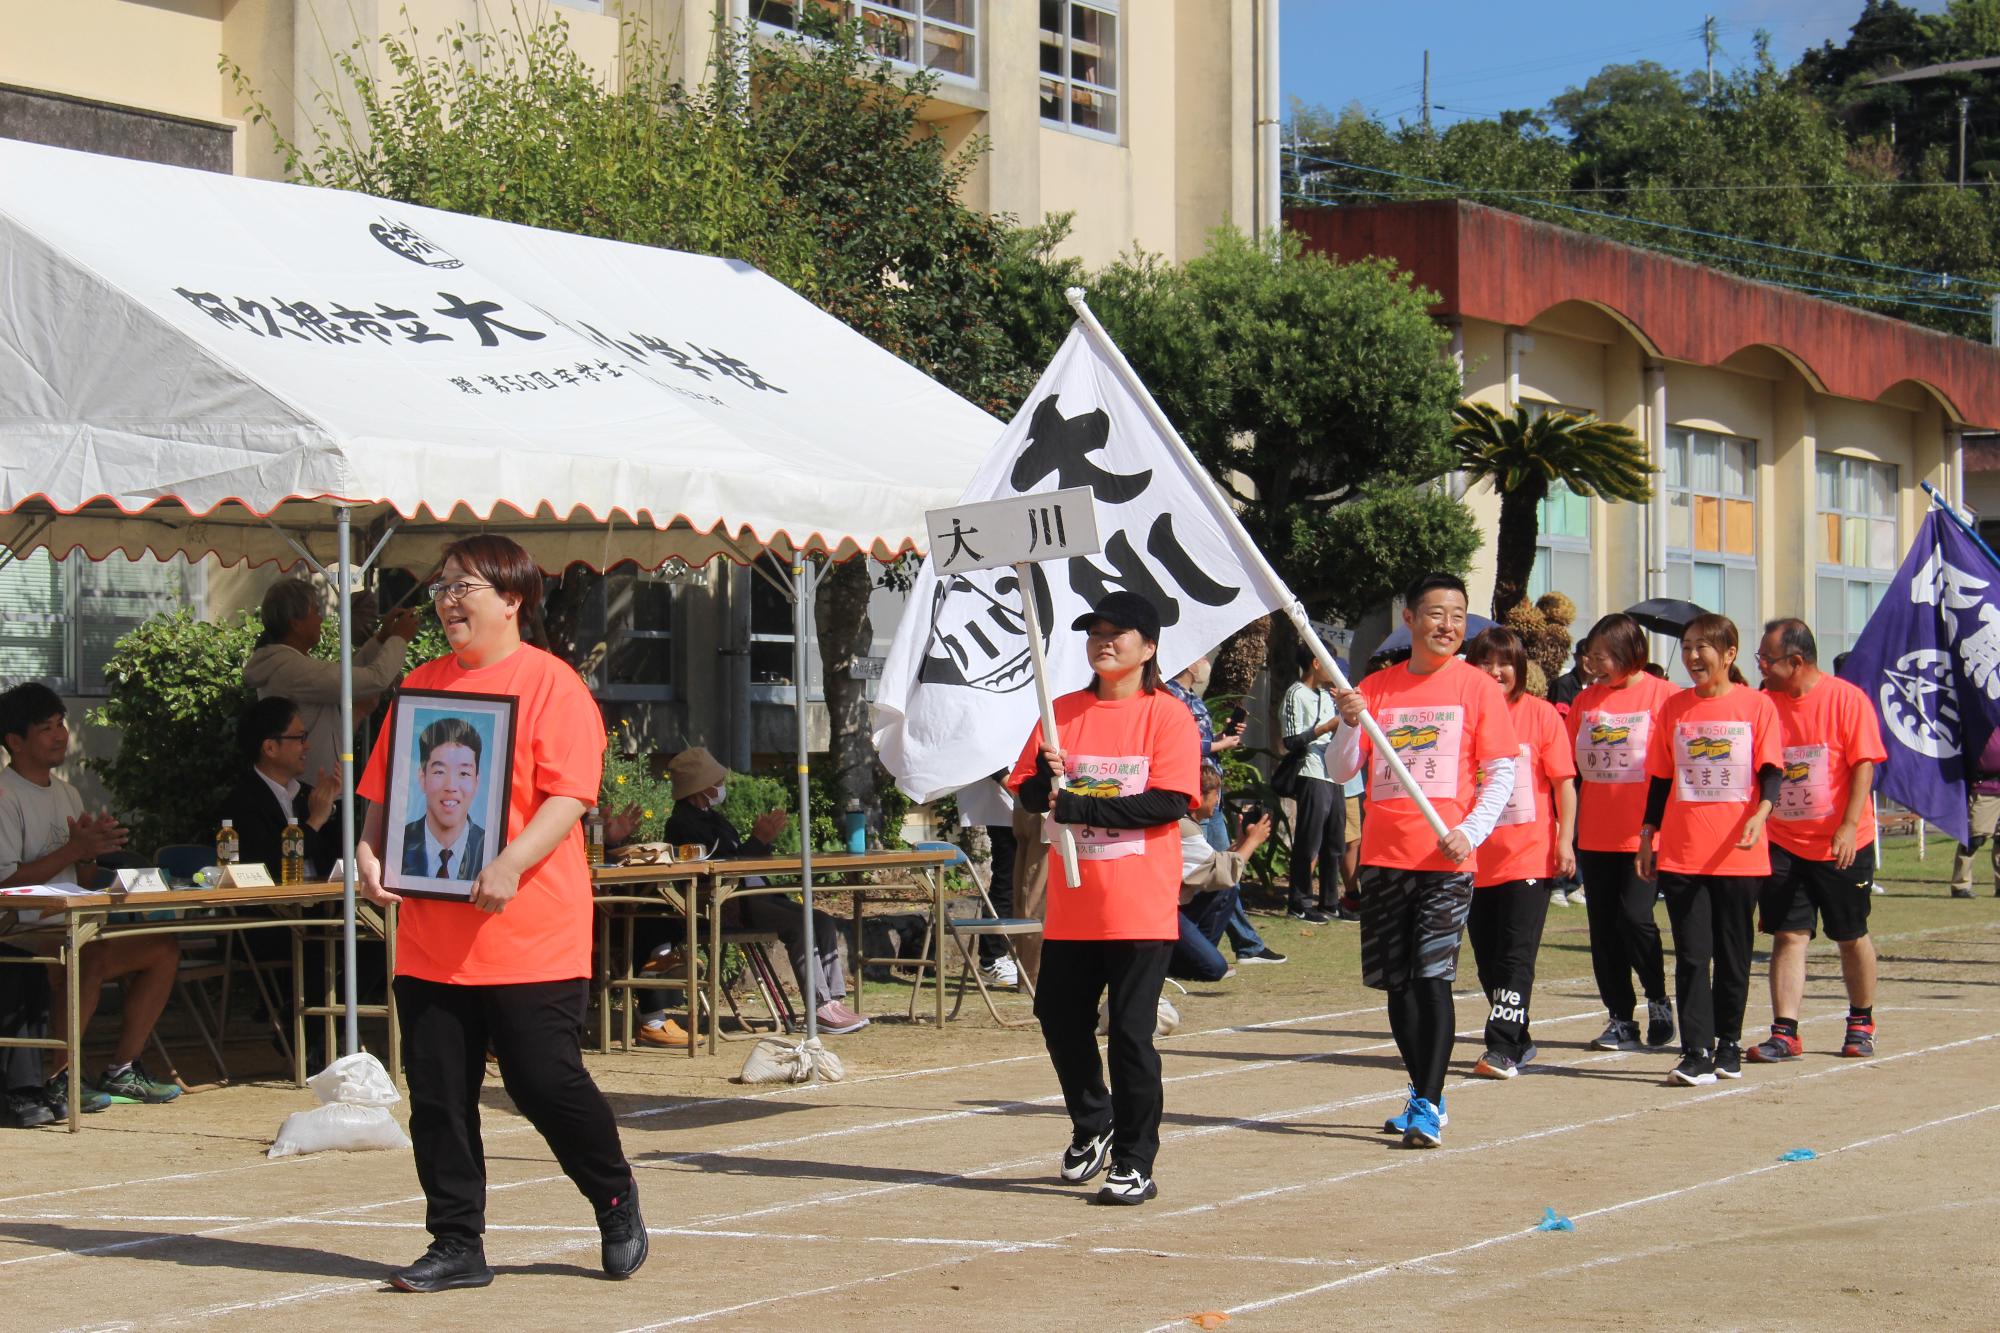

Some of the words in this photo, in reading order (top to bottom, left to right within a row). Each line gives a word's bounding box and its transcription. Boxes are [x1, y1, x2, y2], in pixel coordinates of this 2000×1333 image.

[938, 505, 1068, 567] 大川
[1587, 752, 1629, 768] ゆうこ
[1077, 762, 1140, 775] 華の50歳組
[1685, 767, 1731, 787] こまき
[1075, 844, 1105, 855] 久根市
